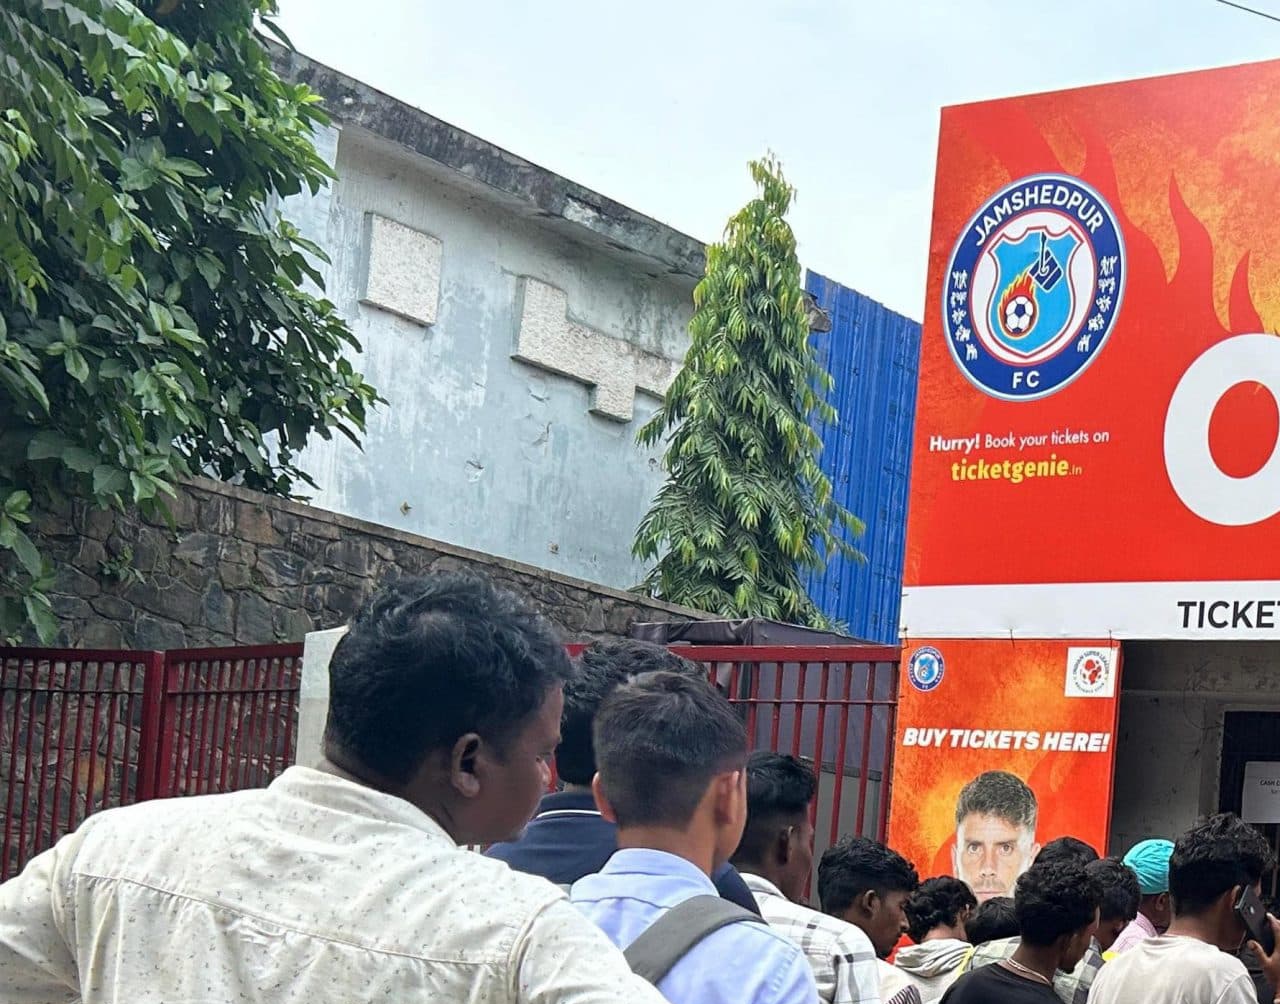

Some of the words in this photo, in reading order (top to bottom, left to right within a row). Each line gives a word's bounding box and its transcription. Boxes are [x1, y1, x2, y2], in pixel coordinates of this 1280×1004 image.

[973, 183, 1105, 248] JAMSHEDPUR
[1012, 370, 1041, 390] FC
[929, 432, 981, 452] Hurry!
[985, 432, 1016, 448] Book
[1018, 433, 1048, 449] your
[1051, 429, 1089, 445] tickets
[1092, 430, 1110, 443] on
[950, 454, 1083, 484] ticketgenie.in
[903, 728, 947, 747] BUY
[949, 729, 1041, 750] TICKETS
[1042, 732, 1111, 752] HERE!
